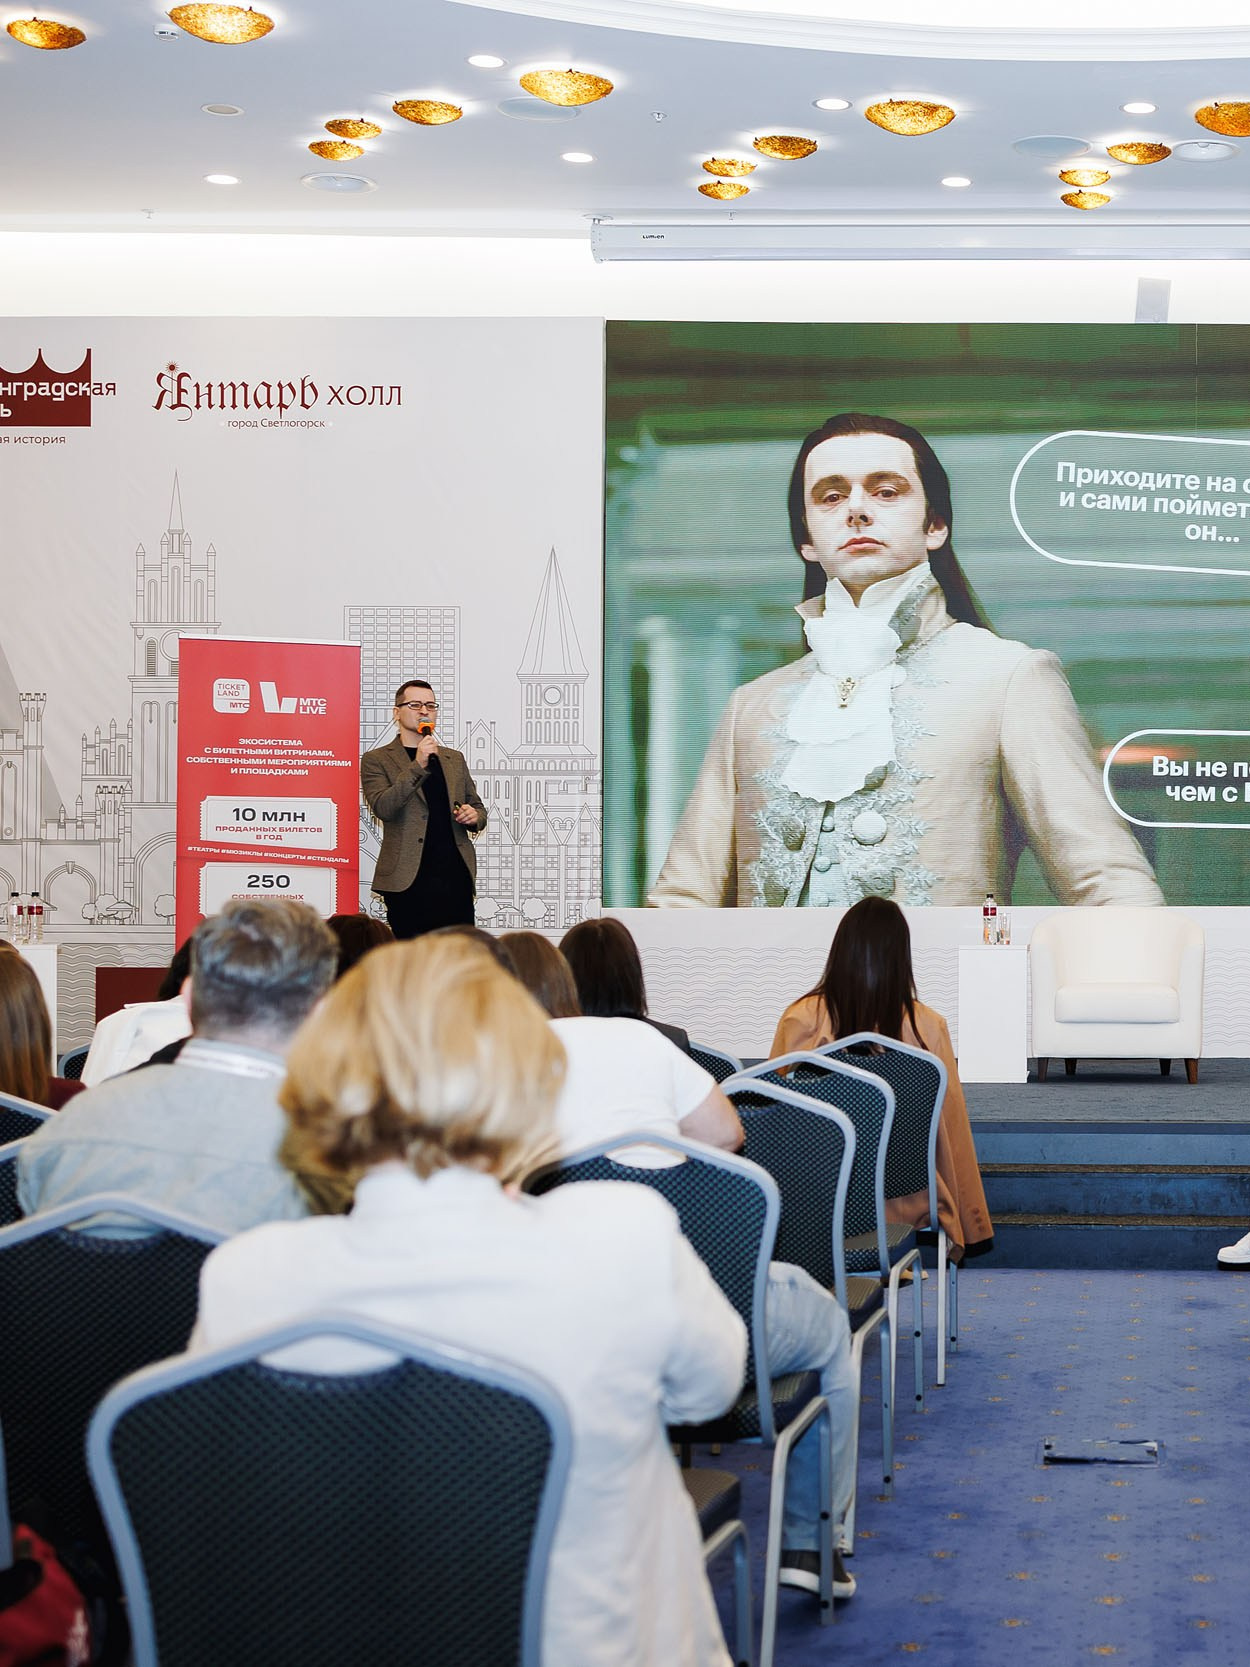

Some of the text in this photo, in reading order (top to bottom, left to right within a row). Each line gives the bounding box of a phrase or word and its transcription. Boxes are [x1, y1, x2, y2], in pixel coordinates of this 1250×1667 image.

[227, 418, 325, 429] город Светлогорск
[14, 436, 66, 446] история
[1056, 461, 1200, 490] Приходите
[1206, 474, 1236, 493] на
[1059, 490, 1075, 507] и
[1081, 492, 1147, 513] сами
[1185, 523, 1240, 543] он...
[217, 683, 246, 691] TICKET
[300, 706, 327, 715] LIVE
[238, 738, 303, 747] ЭКОСИСТЕМА
[212, 747, 273, 756] БИЛЕТНЫМИ
[274, 749, 335, 758] ВИТРИНАМИ,
[186, 756, 352, 767] СОБСТВЕННЫМИ МЕРОПРИЯТИЯМИ
[1152, 755, 1189, 777] Вы
[1196, 761, 1228, 778] не
[230, 767, 309, 776] И ПЛОЩАДКАМИ
[1165, 784, 1216, 802] чем
[1222, 785, 1238, 803] с
[232, 807, 256, 822] 10
[215, 825, 323, 834] ПРОДАННЫХ БИЛЕТОВ
[187, 846, 221, 854] #ТЕАТРЫ
[247, 874, 291, 889] 250
